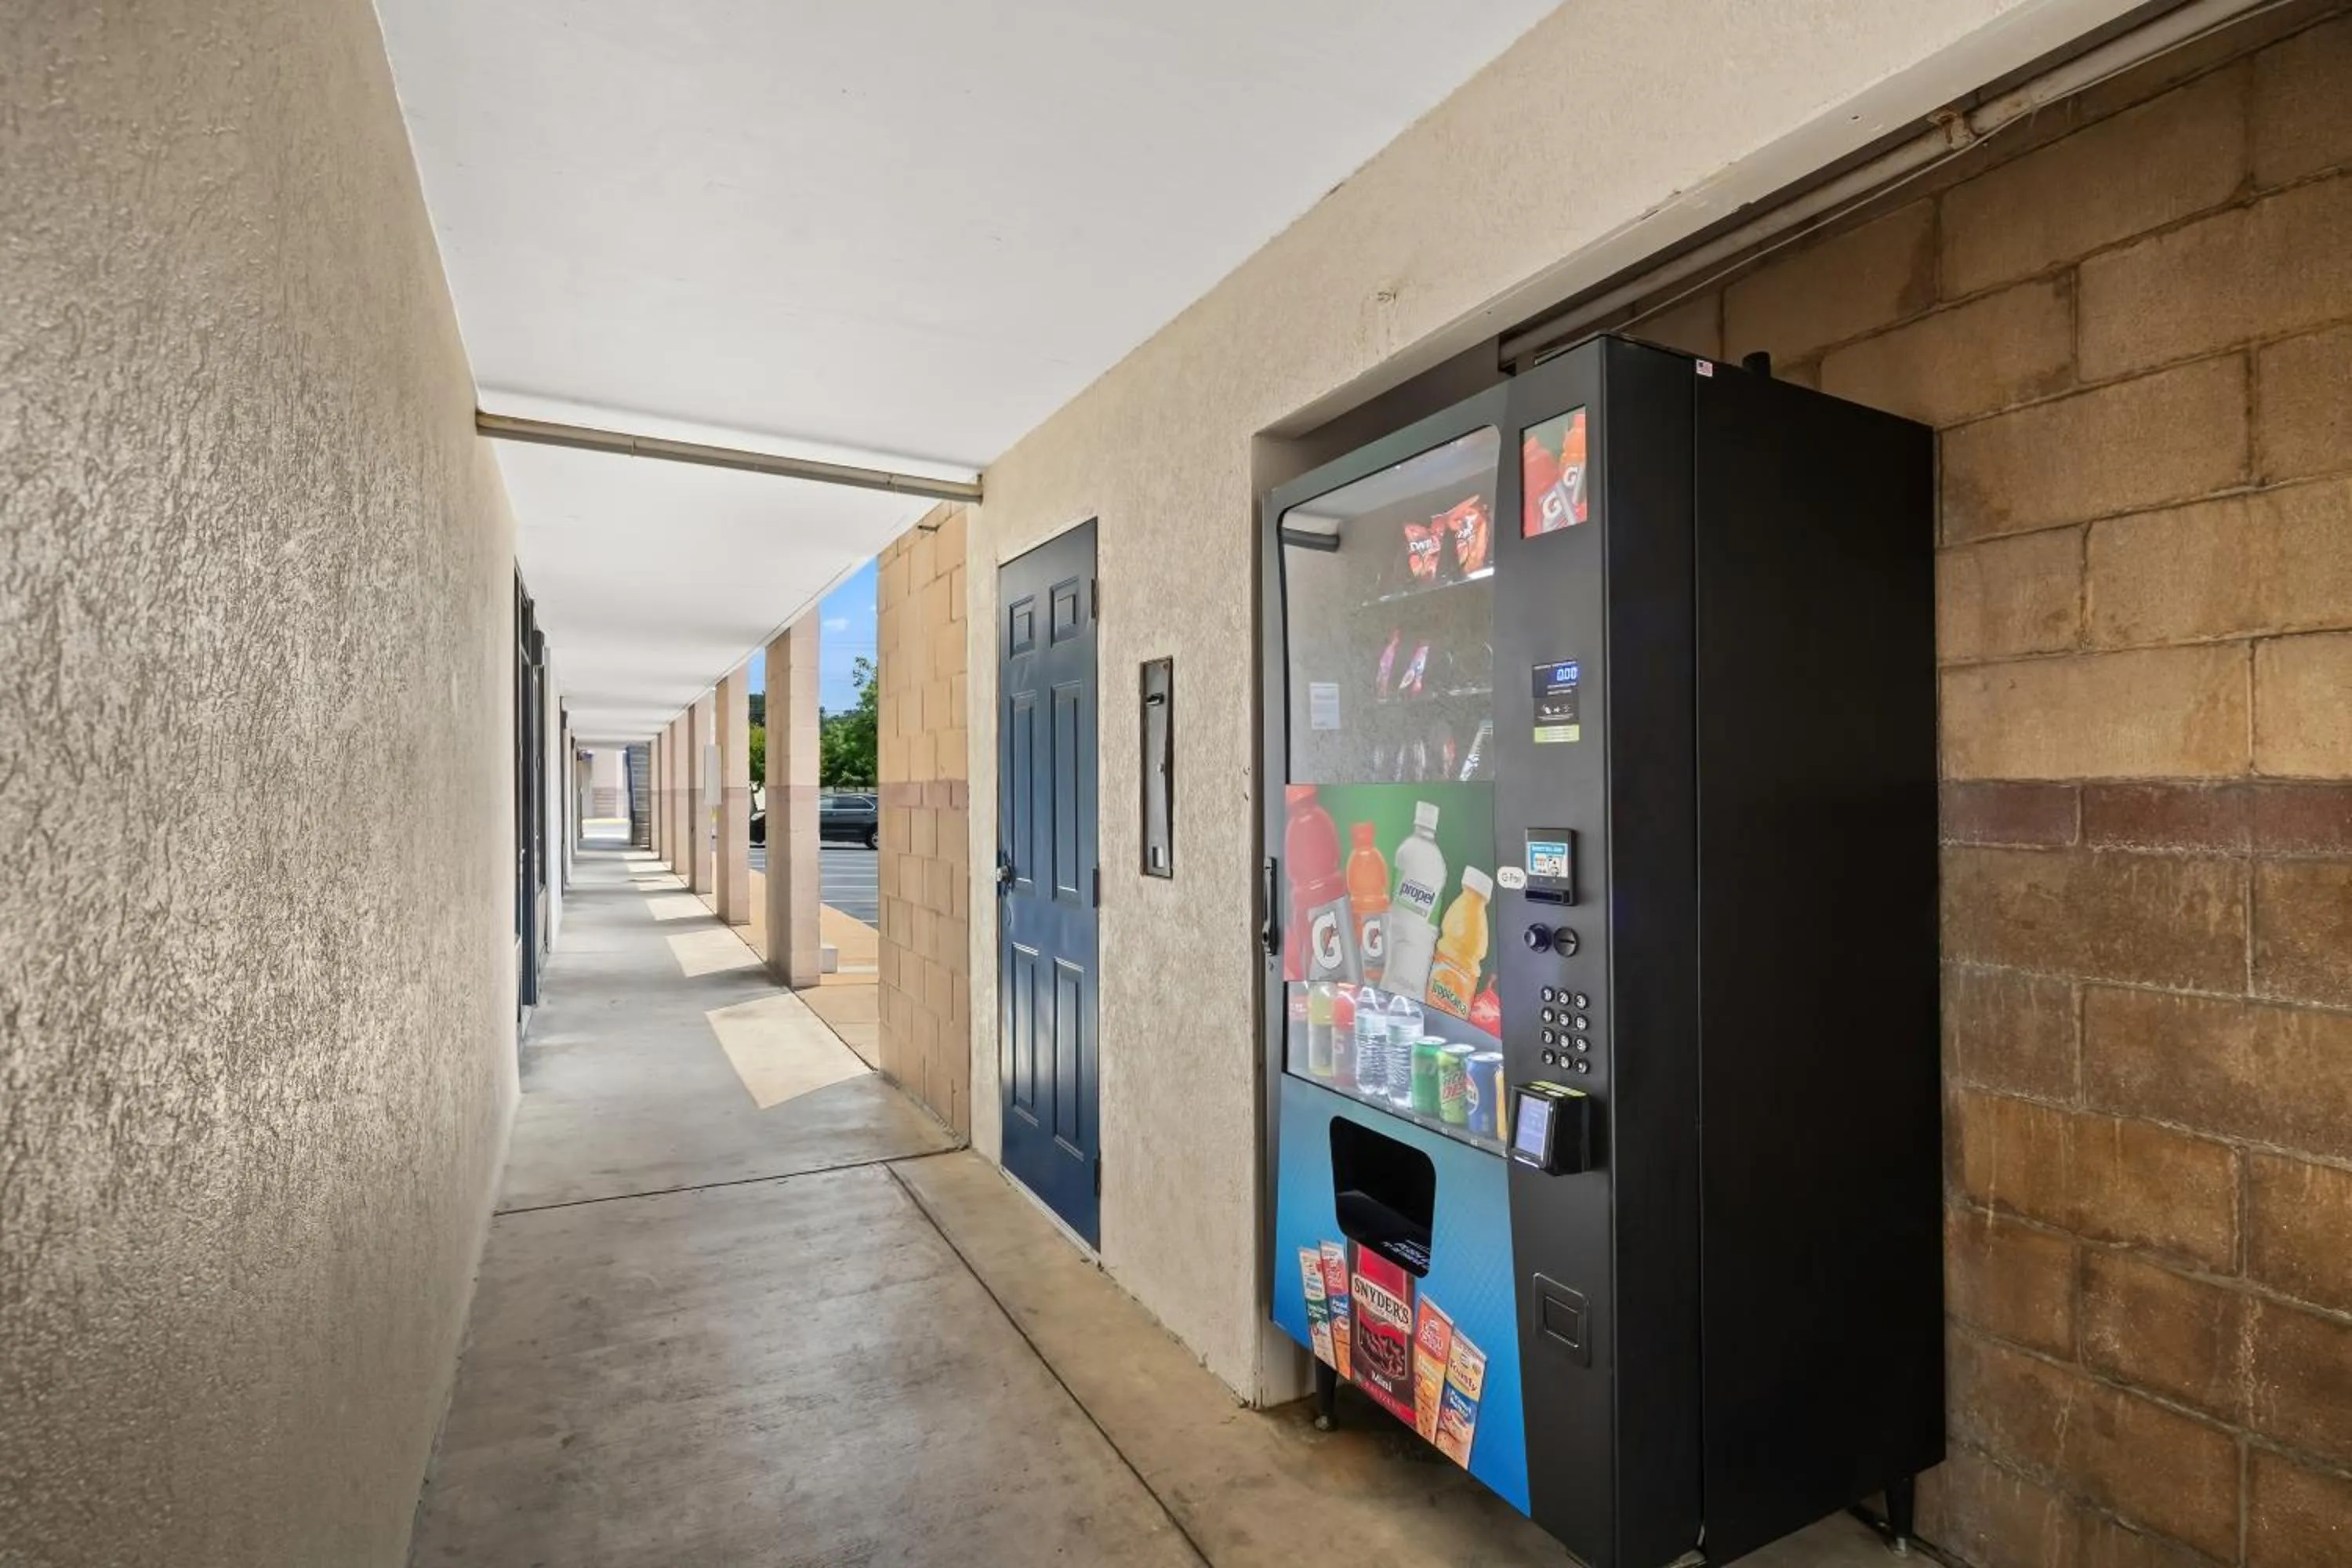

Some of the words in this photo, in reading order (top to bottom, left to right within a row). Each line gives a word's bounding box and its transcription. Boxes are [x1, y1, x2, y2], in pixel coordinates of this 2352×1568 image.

[1563, 466, 1578, 487] G
[1542, 491, 1562, 518] G
[1399, 883, 1436, 905] propel
[1312, 911, 1343, 970] G
[1363, 920, 1383, 957] G
[1354, 1277, 1409, 1324] SNYDER'S
[1371, 1369, 1392, 1392] Mini
